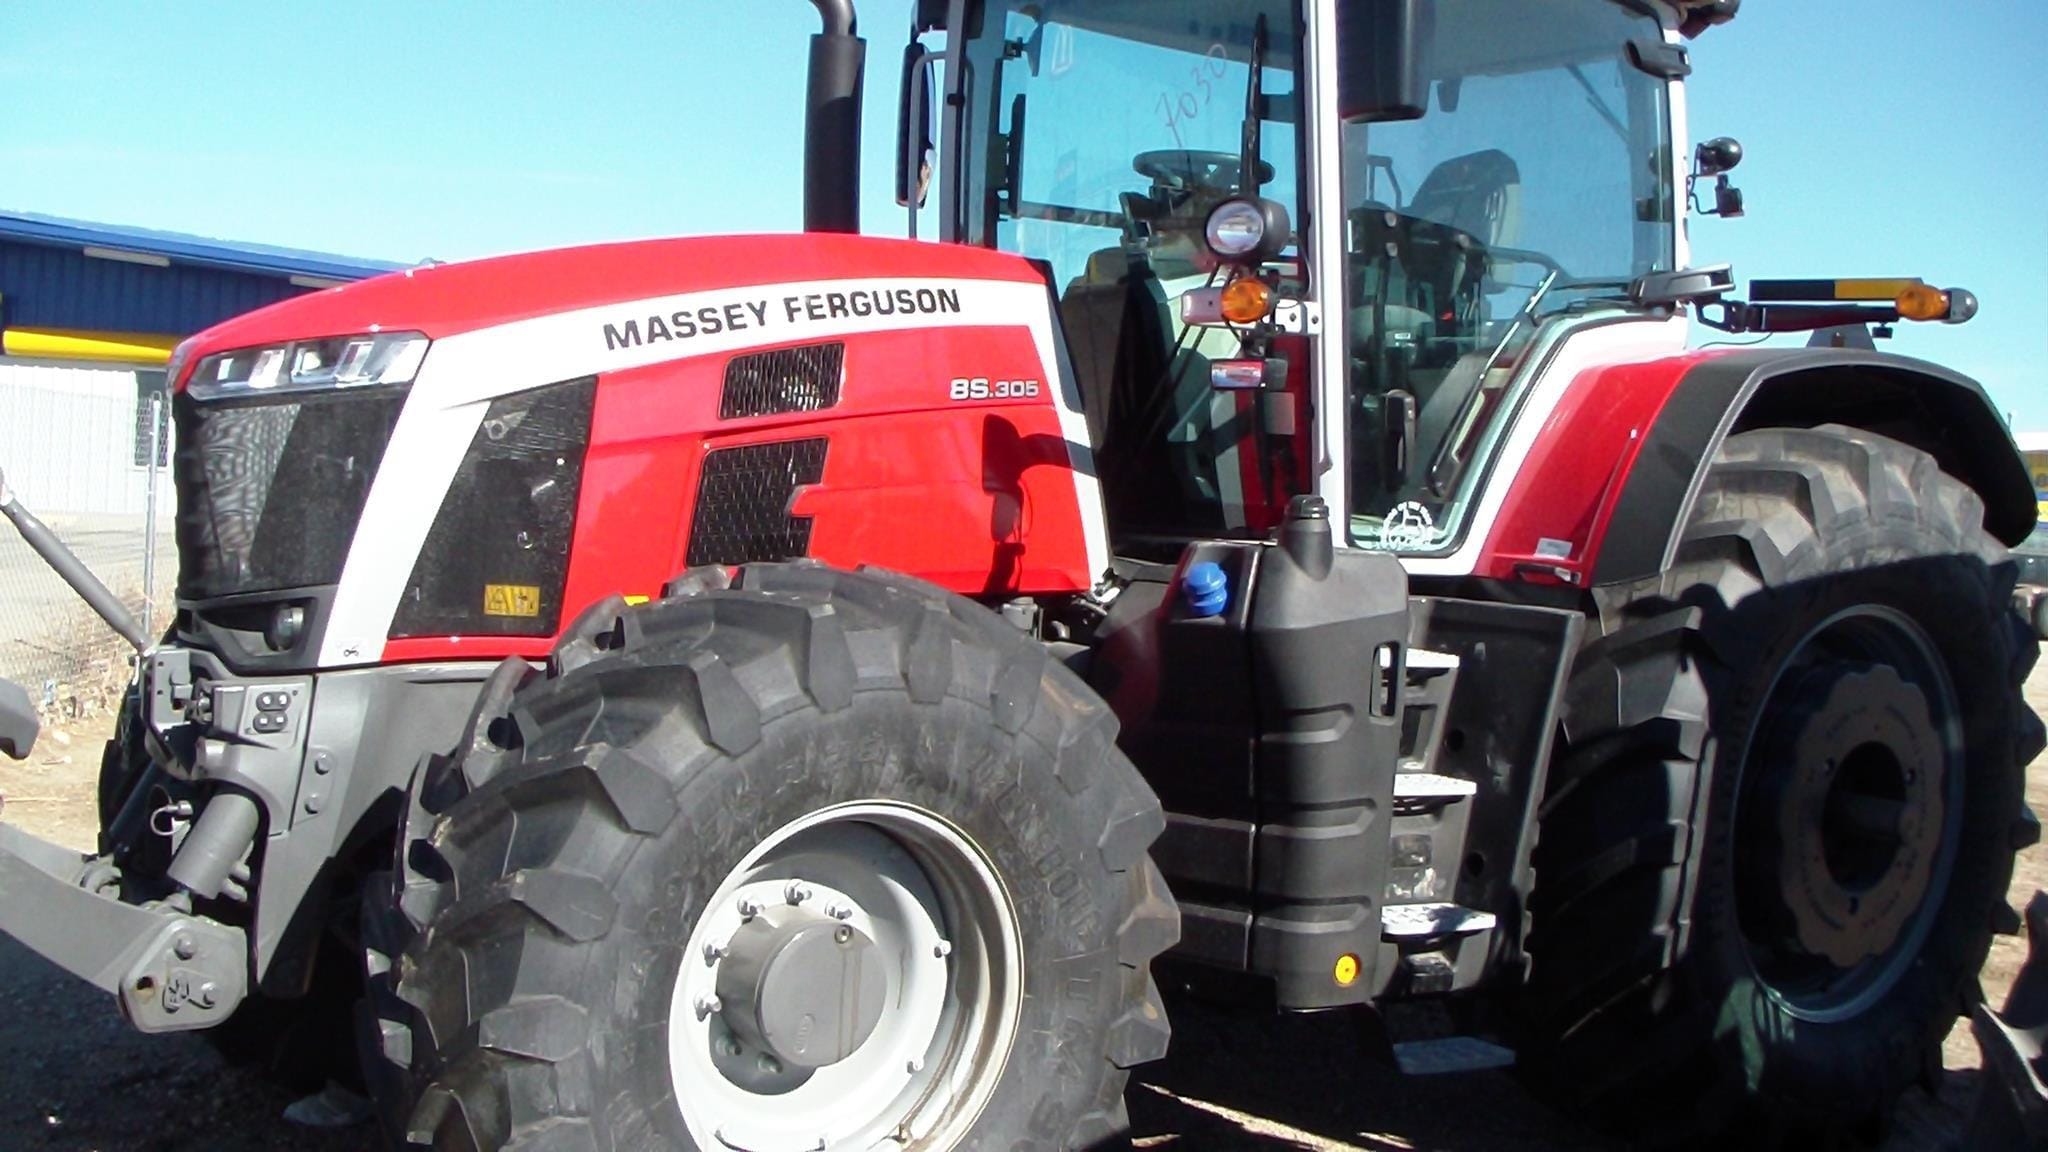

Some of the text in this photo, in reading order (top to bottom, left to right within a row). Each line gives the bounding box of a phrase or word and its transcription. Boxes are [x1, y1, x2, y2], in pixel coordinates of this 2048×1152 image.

[603, 288, 961, 350] MASSEY FERGUSON
[950, 377, 1040, 400] 8S.305
